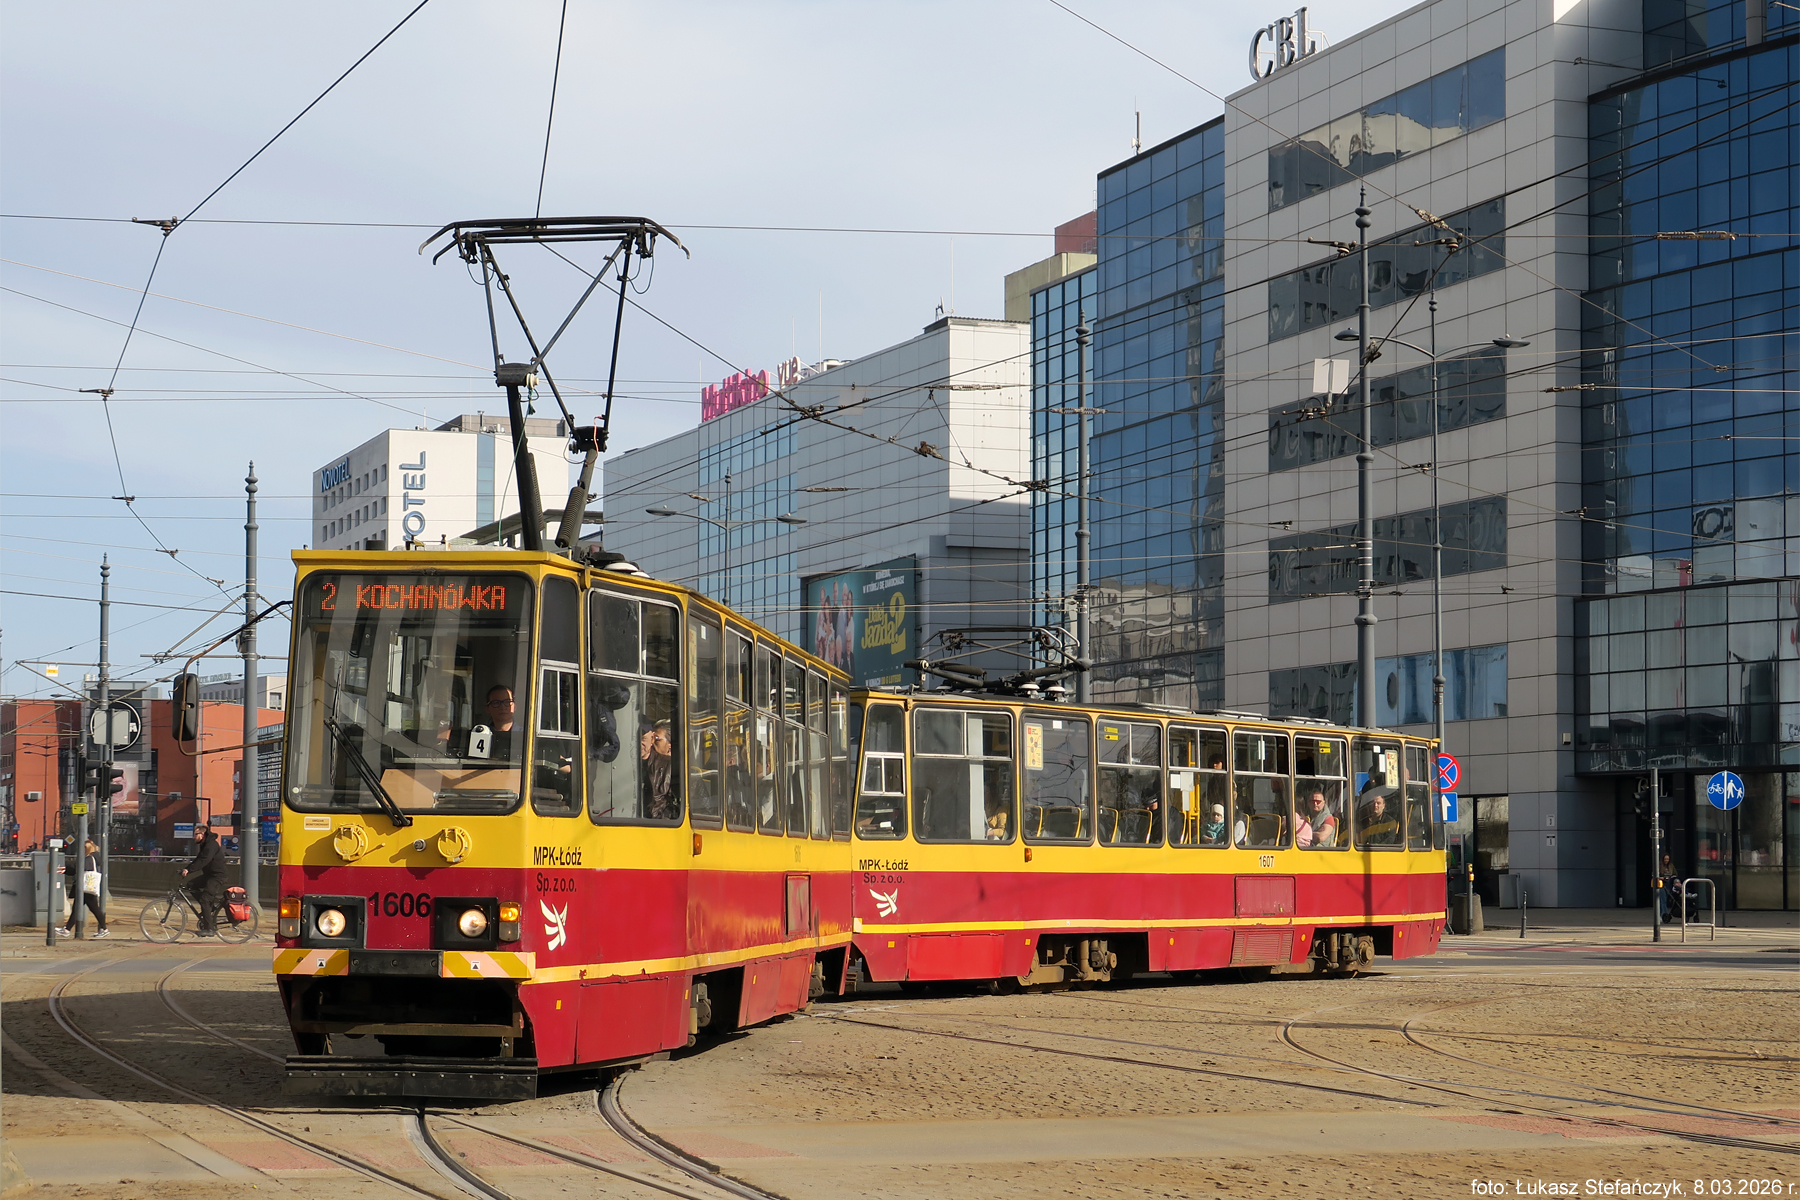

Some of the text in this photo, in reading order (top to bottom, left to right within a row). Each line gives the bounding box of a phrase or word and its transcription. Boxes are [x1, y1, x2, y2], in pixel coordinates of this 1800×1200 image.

[1249, 6, 1316, 81] CBL
[321, 457, 351, 492] NOVOTEL
[399, 451, 426, 541] OTEL
[321, 582, 506, 610] 2 KOCHANÓWKA
[476, 738, 485, 754] 4
[1259, 855, 1275, 868] 1607
[368, 891, 431, 918] 1606
